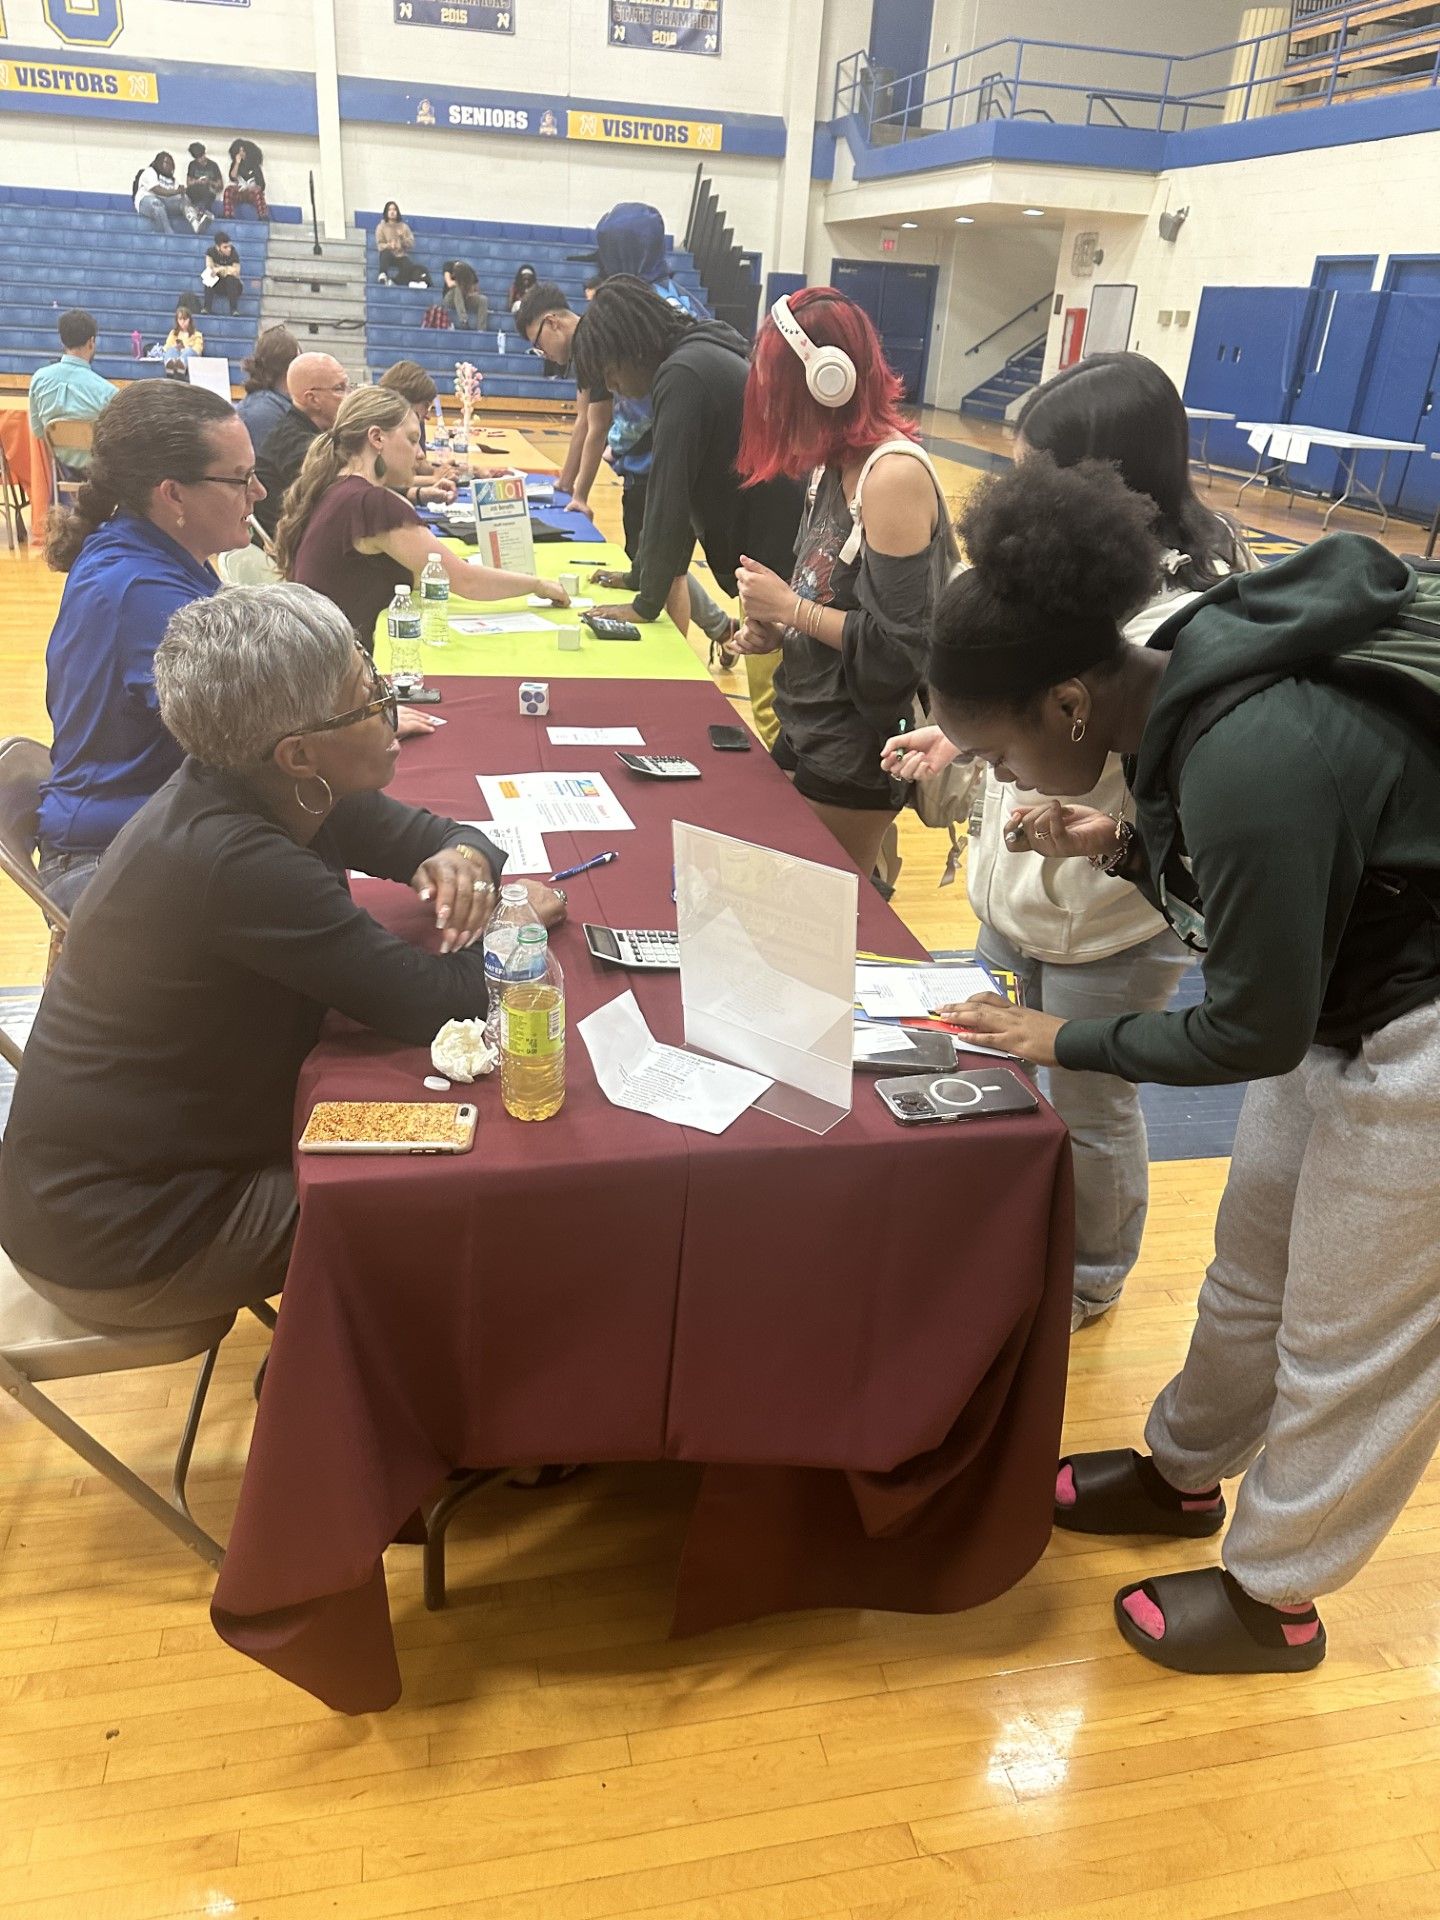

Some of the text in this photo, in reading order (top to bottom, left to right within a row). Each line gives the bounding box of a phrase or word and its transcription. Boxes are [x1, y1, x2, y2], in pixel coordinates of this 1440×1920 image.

[441, 7, 468, 24] 2015
[613, 4, 718, 32] STATE CHAMPION
[15, 66, 119, 95] VISITORS
[449, 104, 528, 130] SENIORS
[602, 118, 689, 144] VISITORS
